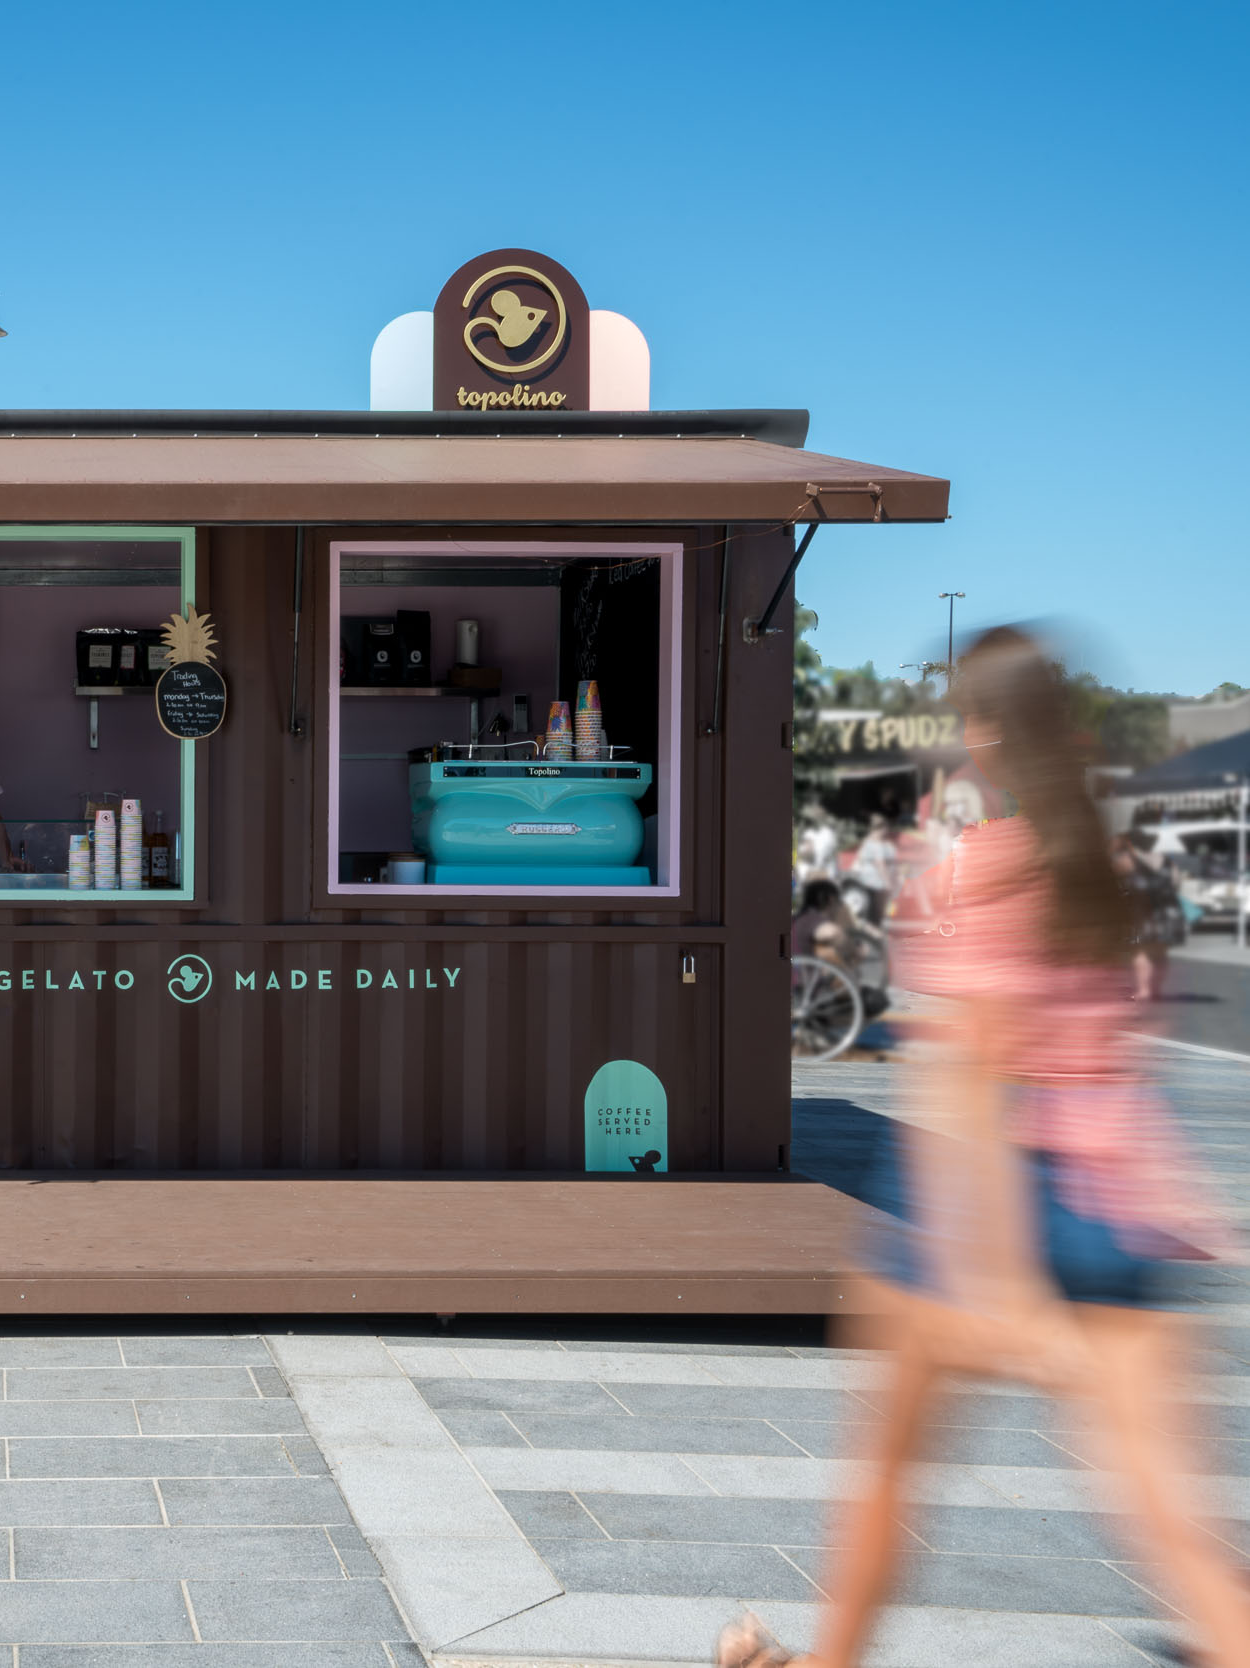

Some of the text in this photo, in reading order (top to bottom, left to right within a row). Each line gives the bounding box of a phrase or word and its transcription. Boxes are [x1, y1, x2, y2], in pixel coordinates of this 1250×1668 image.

[457, 384, 567, 411] topolino
[172, 670, 198, 681] Trading
[528, 767, 561, 777] Topolino
[235, 969, 333, 990] MADE
[355, 967, 461, 990] DAILY
[597, 1107, 652, 1116] COFFEE
[598, 1117, 651, 1126] SERVED
[605, 1127, 642, 1135] HERE
